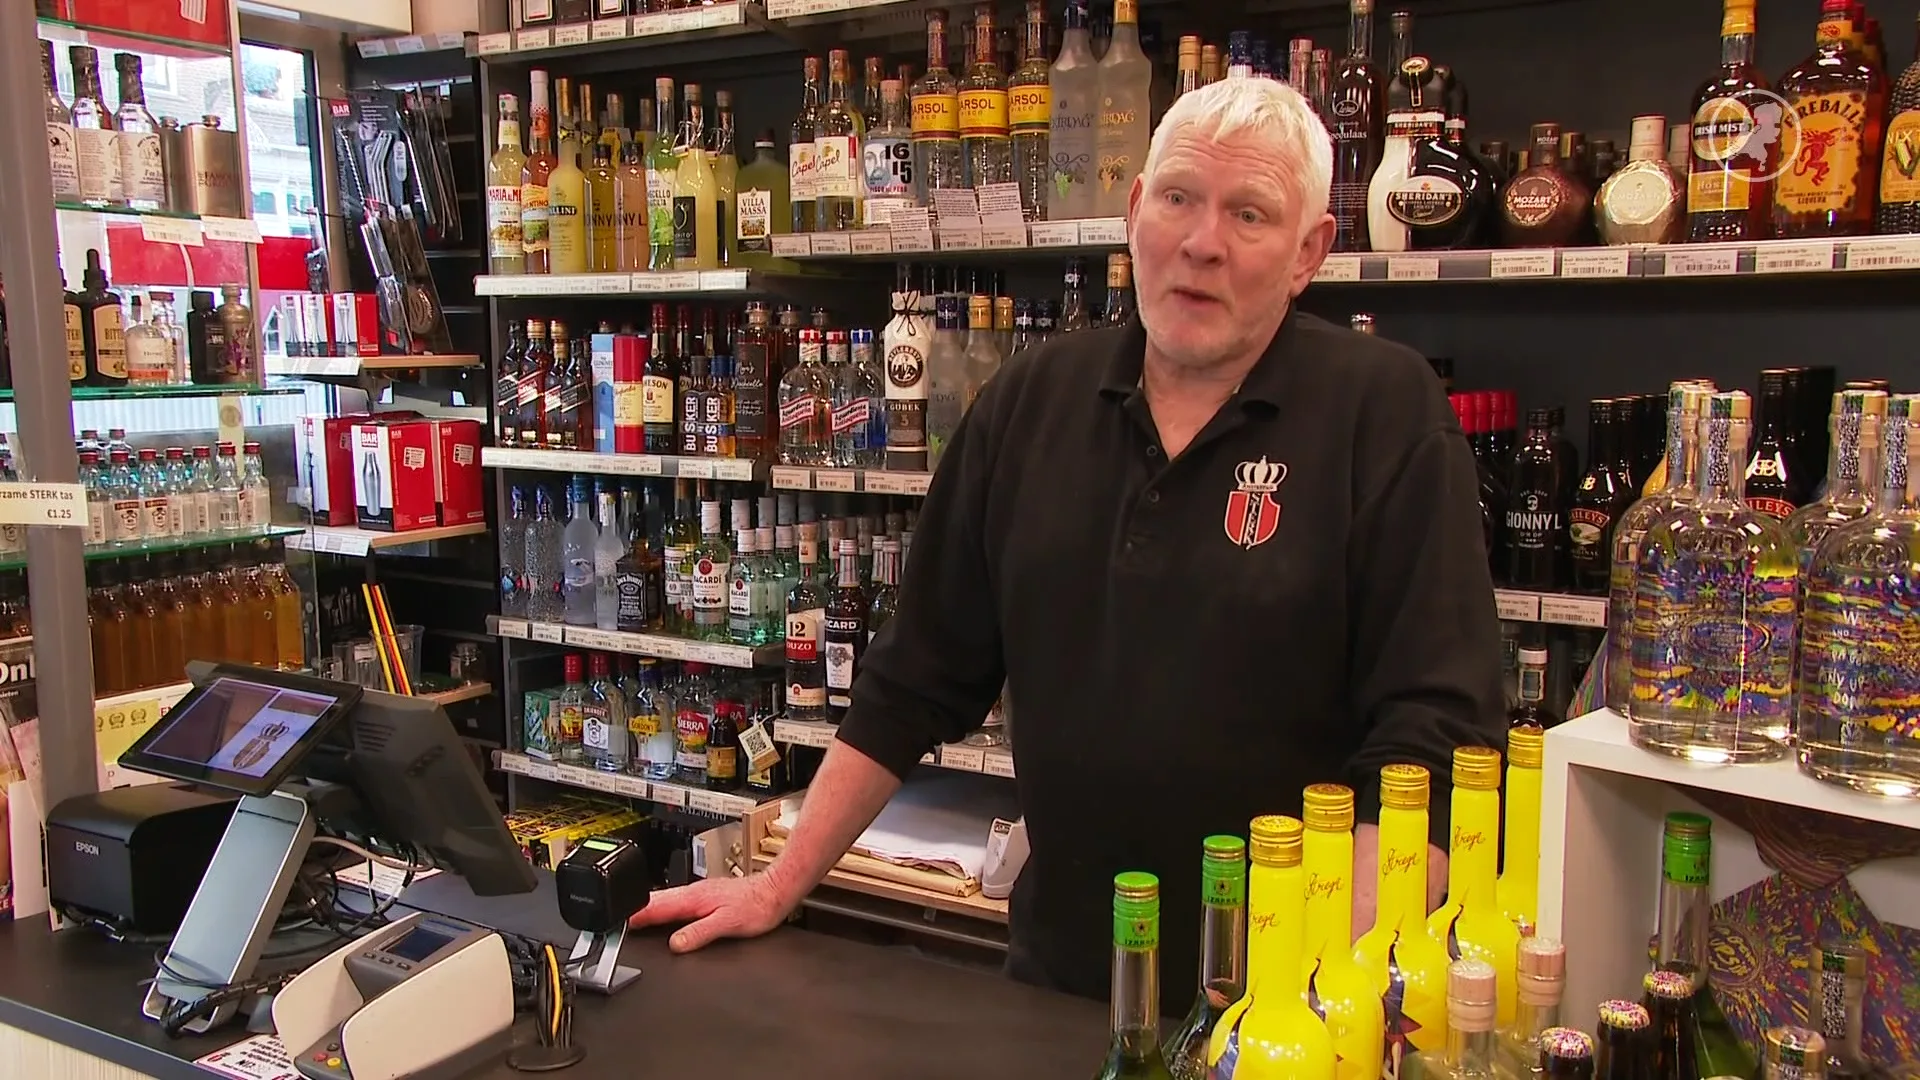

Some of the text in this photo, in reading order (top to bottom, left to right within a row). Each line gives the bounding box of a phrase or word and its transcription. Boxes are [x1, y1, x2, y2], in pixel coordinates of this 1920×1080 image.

[960, 99, 996, 110] ARSOL
[1010, 94, 1047, 105] ARSOL
[332, 104, 350, 115] BAR
[912, 103, 949, 115] ARSOL
[1719, 123, 1745, 132] MIST
[885, 143, 910, 160] 16
[815, 149, 841, 173] Capel
[892, 161, 912, 184] 15
[1396, 192, 1453, 200] SHERIDAN'S
[1513, 196, 1553, 204] MOZART
[742, 198, 765, 207] VILLA
[740, 207, 767, 216] MASSA
[684, 396, 698, 451] BUSKER
[704, 397, 719, 453] BUSKER
[361, 432, 378, 443] BAR
[29, 489, 58, 500] STERK
[59, 491, 74, 500] tas
[1748, 500, 1790, 516] ILEYS
[47, 509, 72, 519] €1.25
[1570, 511, 1604, 524] AILEYS
[1506, 511, 1562, 530] GIONNY L
[789, 621, 806, 638] 12
[826, 620, 857, 630] CARD
[677, 717, 705, 731] SIERRA
[75, 841, 99, 856] EPSON
